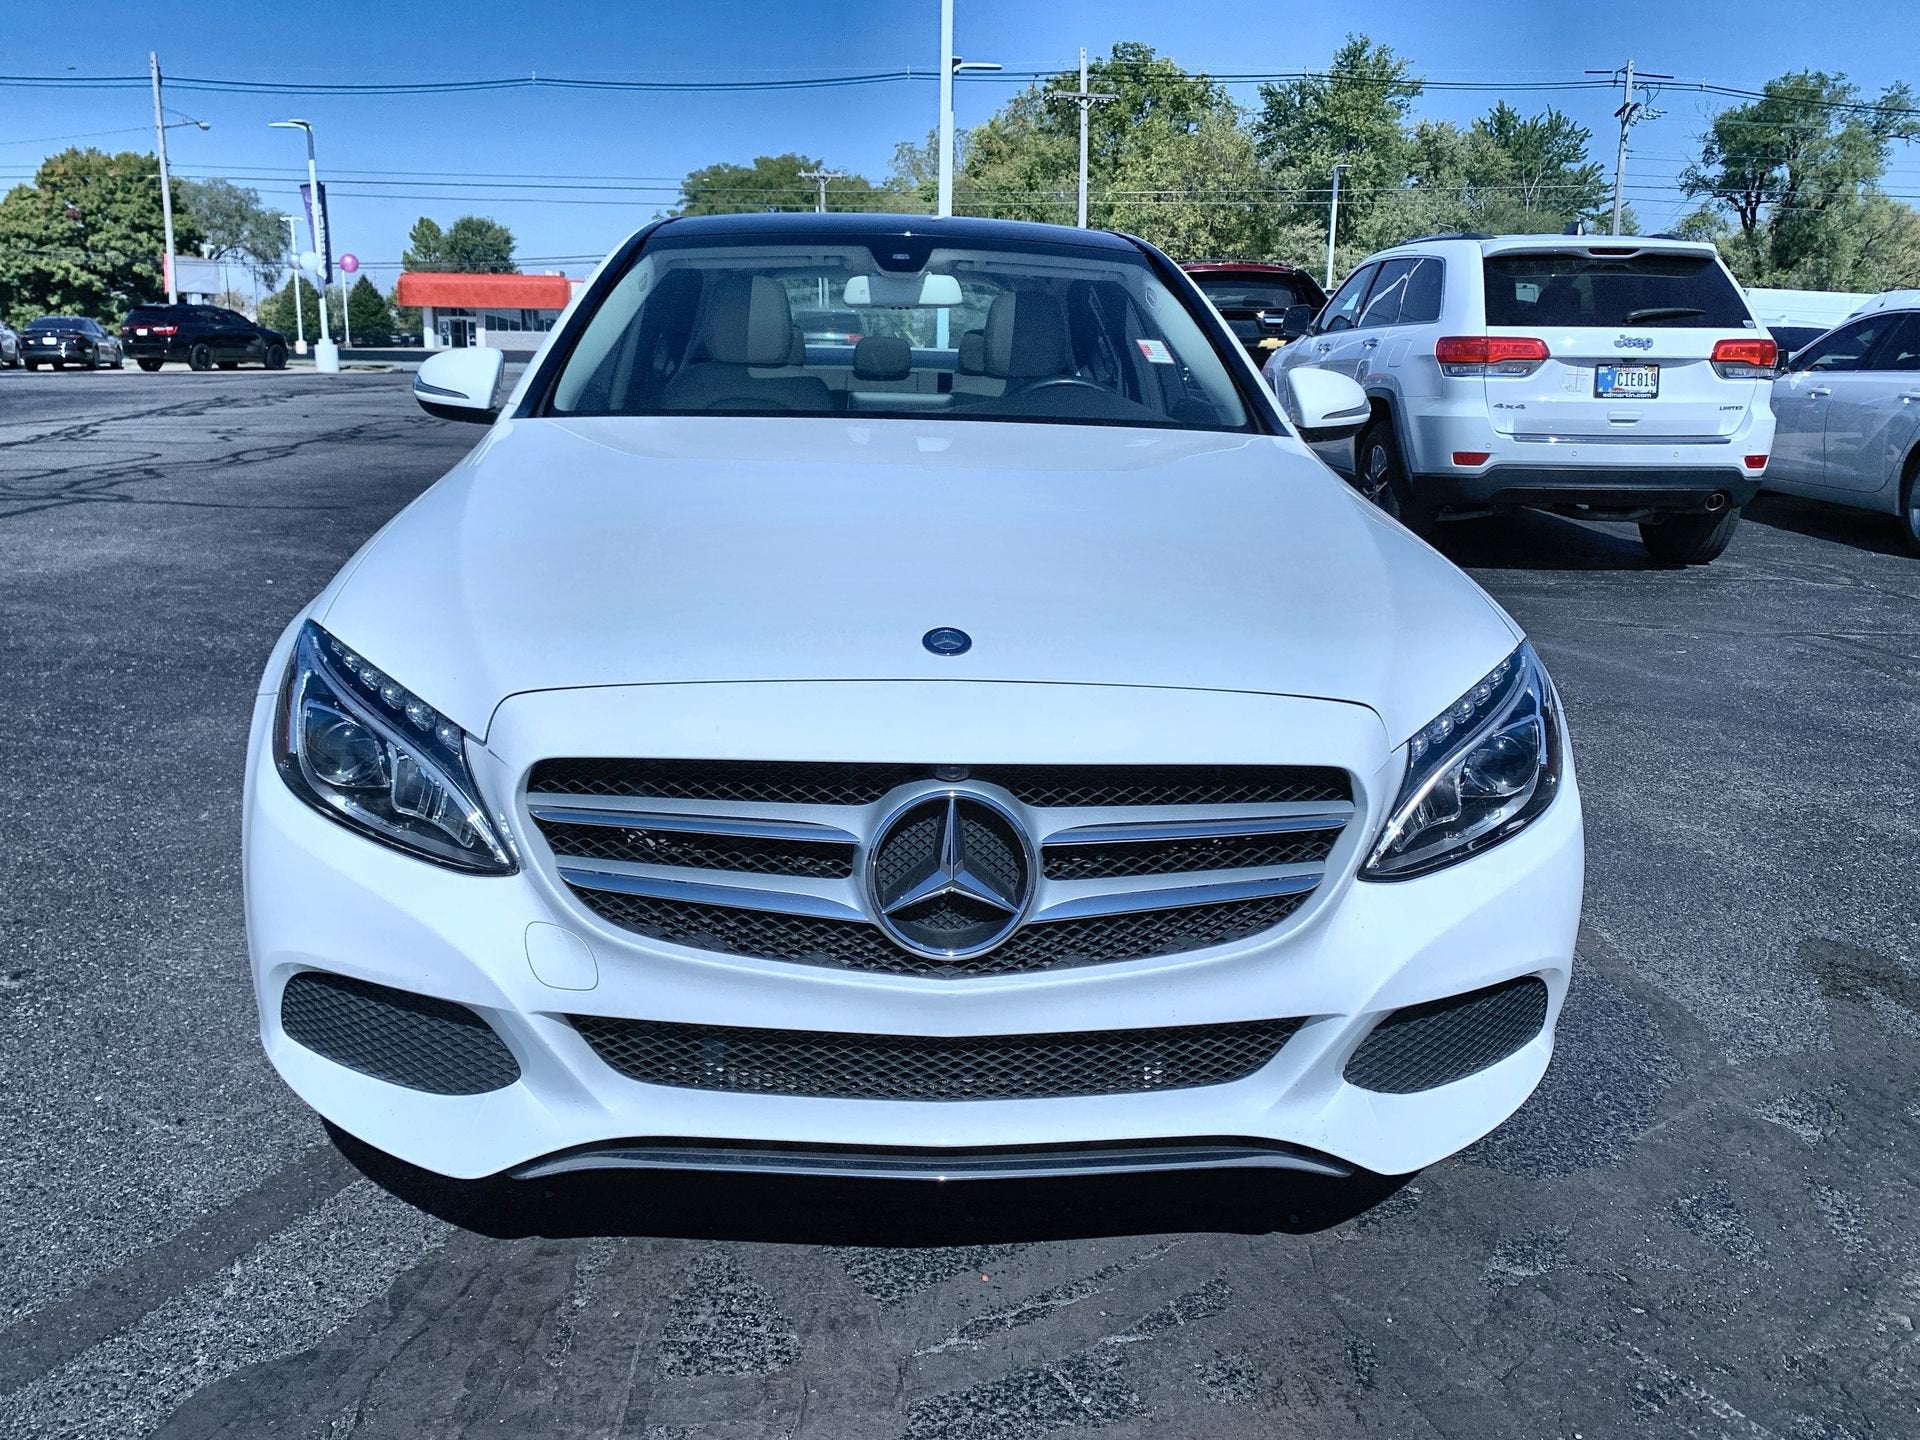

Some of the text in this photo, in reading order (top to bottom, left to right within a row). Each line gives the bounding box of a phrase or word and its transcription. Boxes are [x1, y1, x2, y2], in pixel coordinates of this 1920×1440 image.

[1614, 334, 1654, 351] Jeep
[1617, 373, 1657, 387] CIE819
[1493, 402, 1527, 410] 4x4
